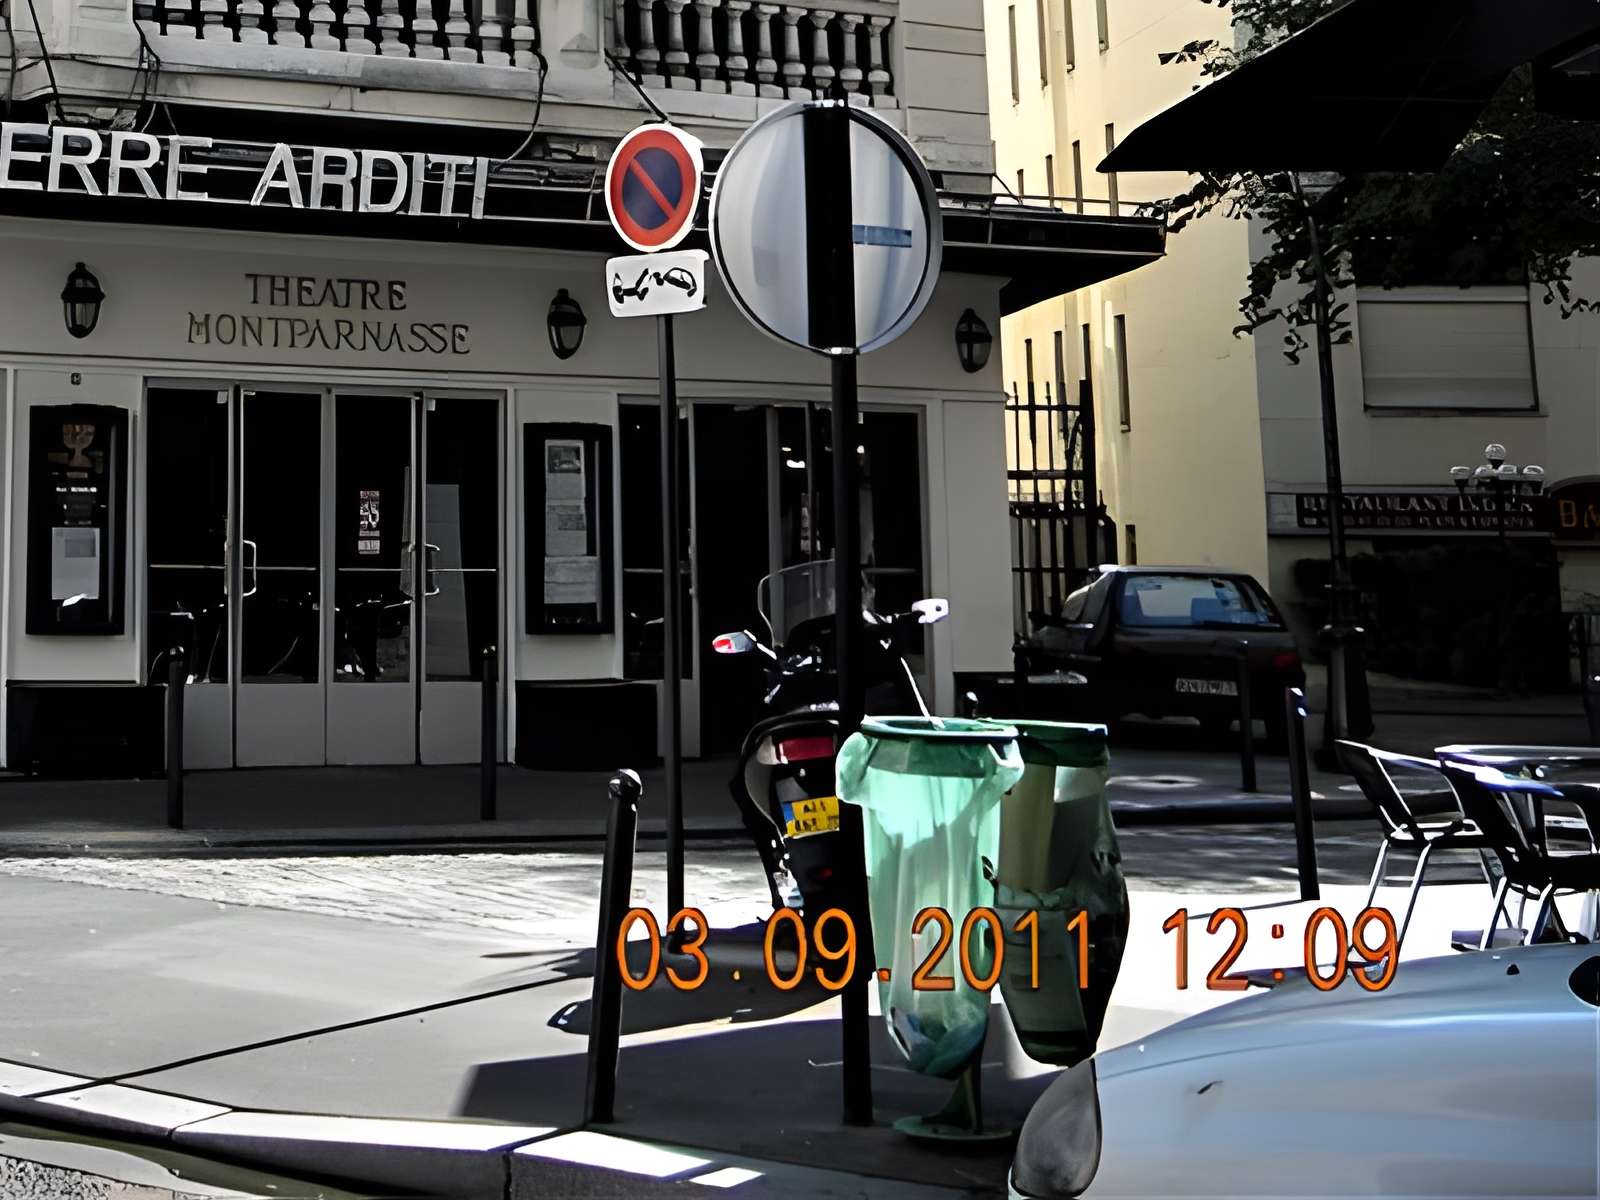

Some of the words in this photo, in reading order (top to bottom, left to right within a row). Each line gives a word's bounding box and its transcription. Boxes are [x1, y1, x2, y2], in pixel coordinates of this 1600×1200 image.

[250, 142, 491, 219] ARDITI
[245, 273, 407, 310] THEATRE
[187, 311, 471, 355] MONTPARNASSE
